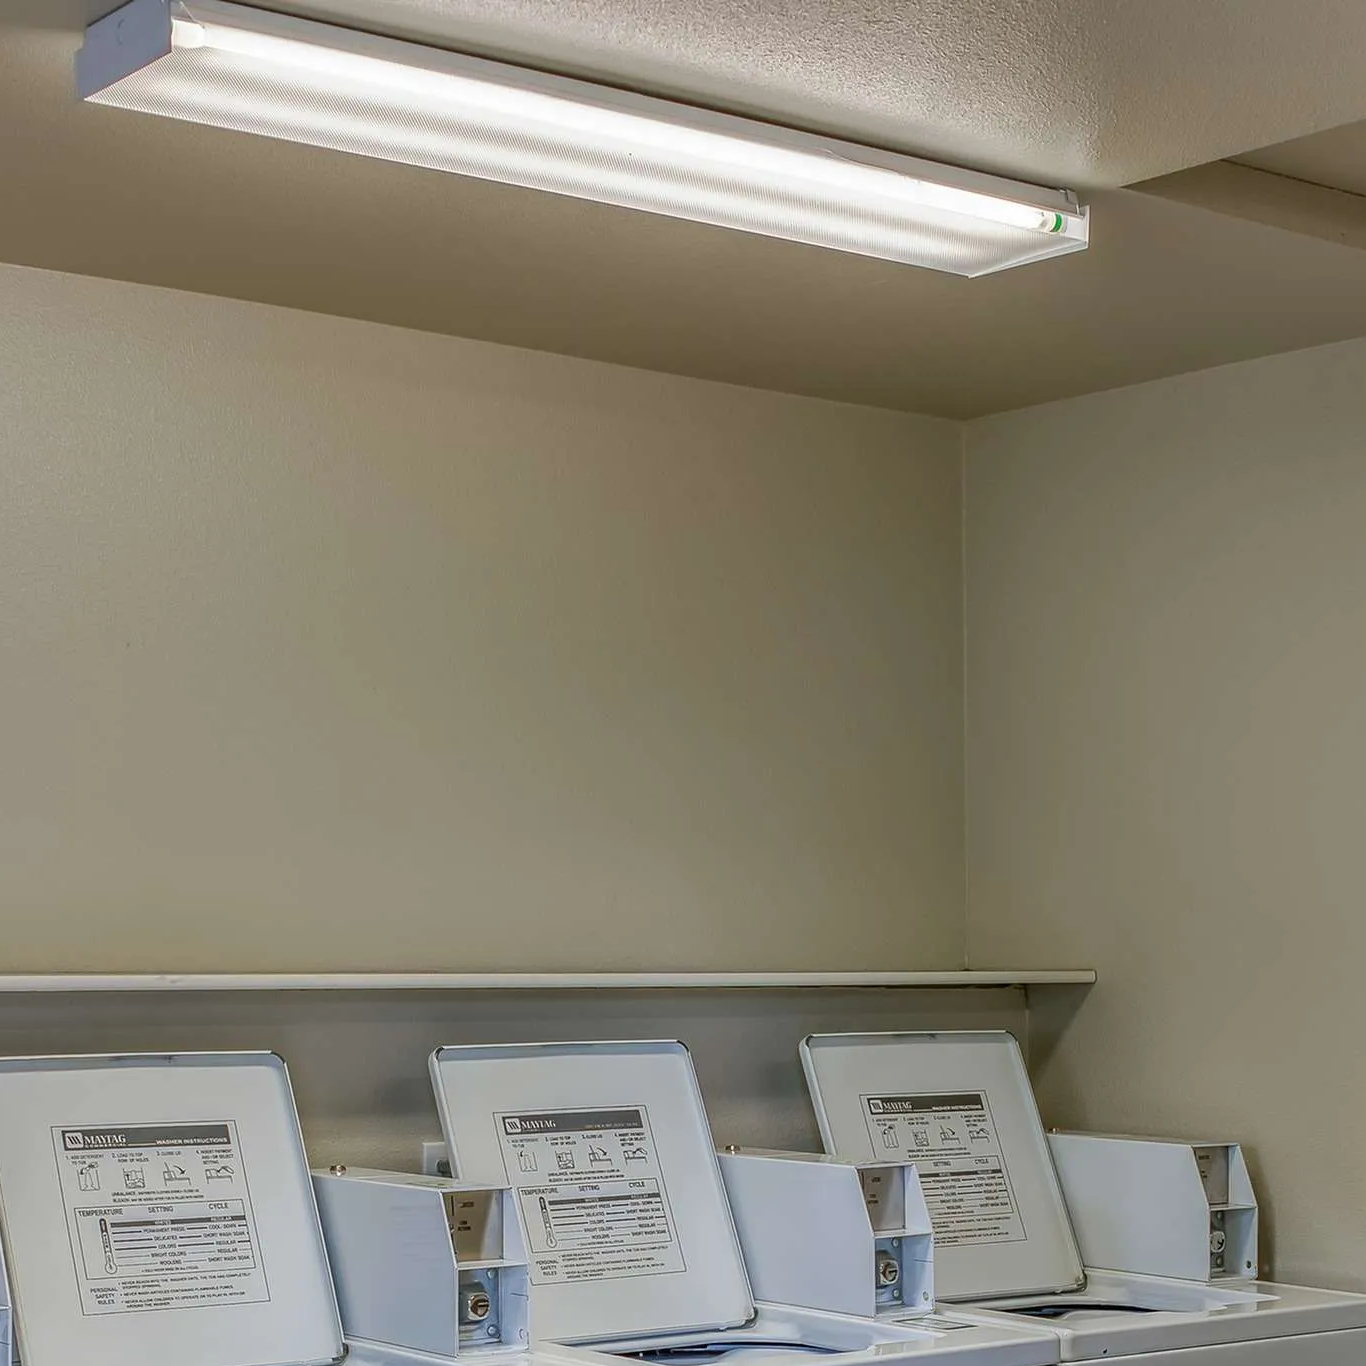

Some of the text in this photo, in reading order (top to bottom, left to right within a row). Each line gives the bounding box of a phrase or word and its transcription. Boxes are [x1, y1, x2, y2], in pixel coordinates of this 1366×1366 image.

[521, 1120, 556, 1129] MAYTAG
[85, 1134, 126, 1144] MAYTAG
[184, 1136, 228, 1144] INSTRUCTIONS
[521, 1187, 559, 1196] TEMPERATURE
[579, 1184, 601, 1192] SETTING
[78, 1202, 229, 1218] TEMPERATURE SETTING CYCLE
